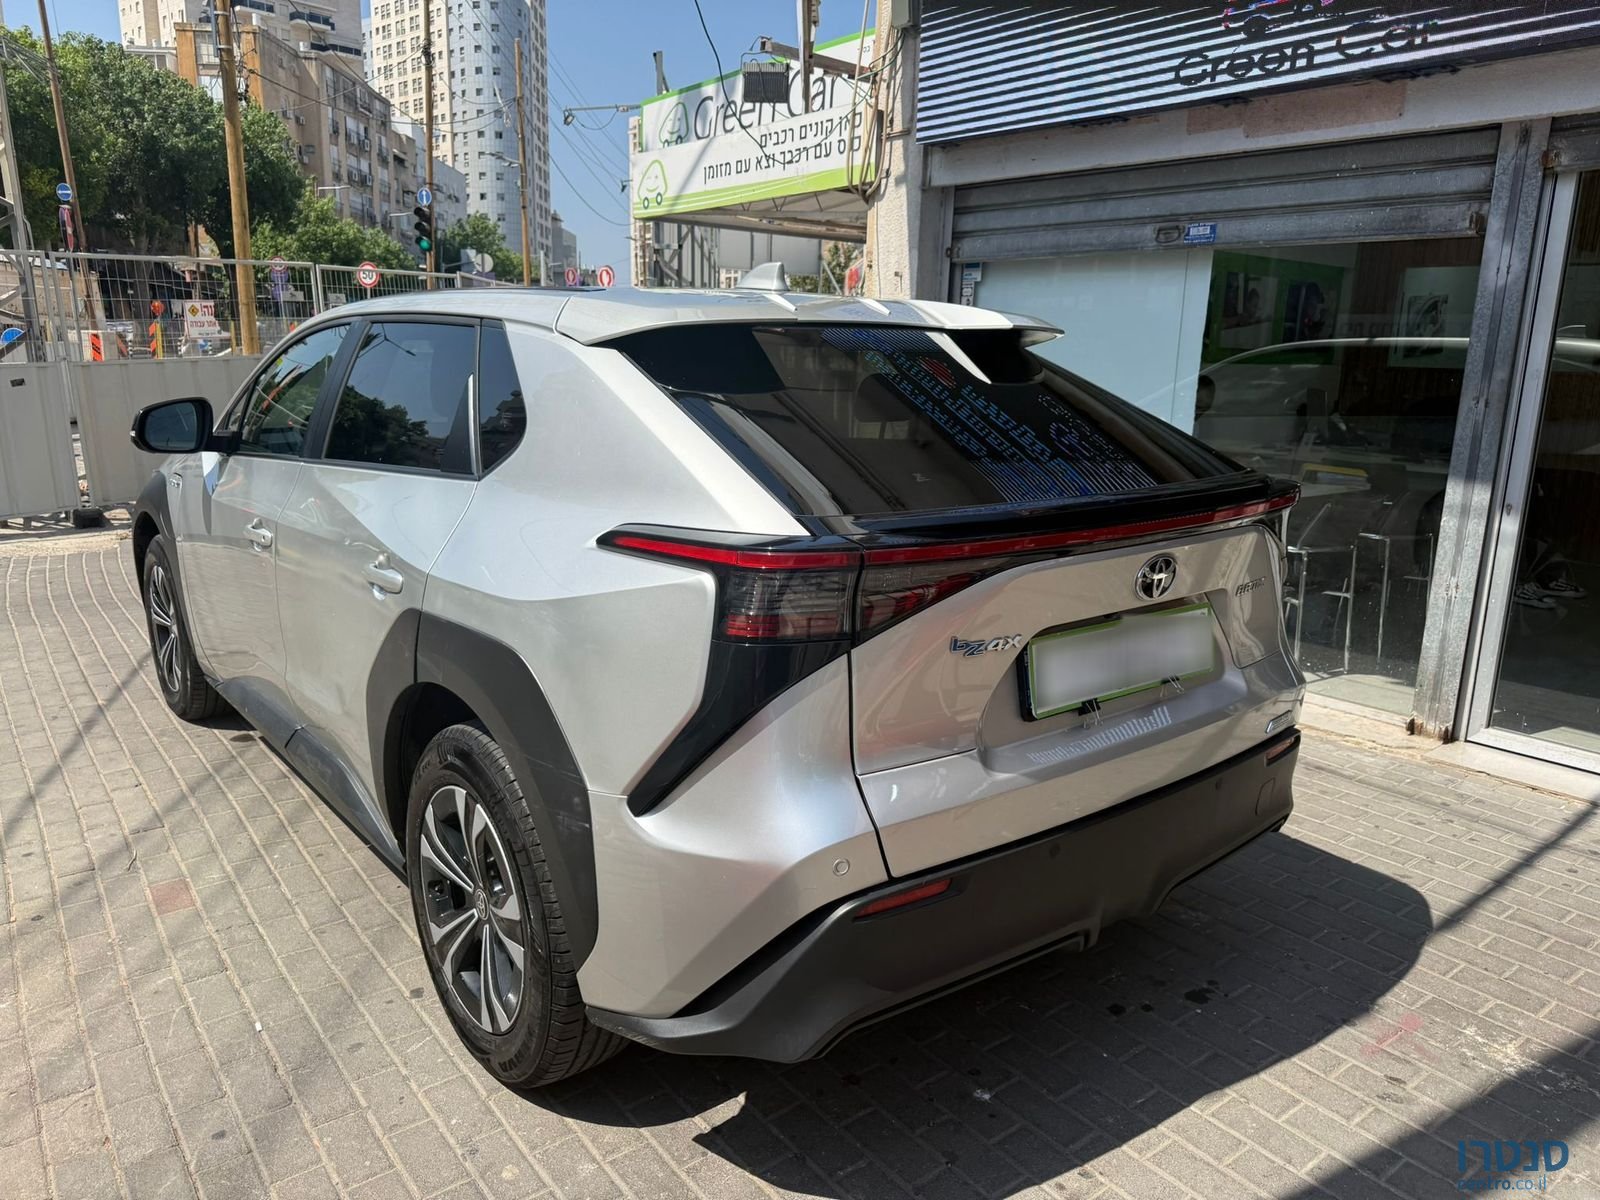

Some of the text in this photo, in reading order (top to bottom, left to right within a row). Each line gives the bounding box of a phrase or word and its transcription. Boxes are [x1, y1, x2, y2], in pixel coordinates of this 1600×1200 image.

[1174, 20, 1437, 87] Green Car
[760, 128, 795, 149] רכבים
[799, 118, 834, 140] קונים
[814, 141, 832, 159] עם
[704, 162, 732, 184] מזומן
[735, 158, 751, 175] עם
[362, 271, 374, 280] 50
